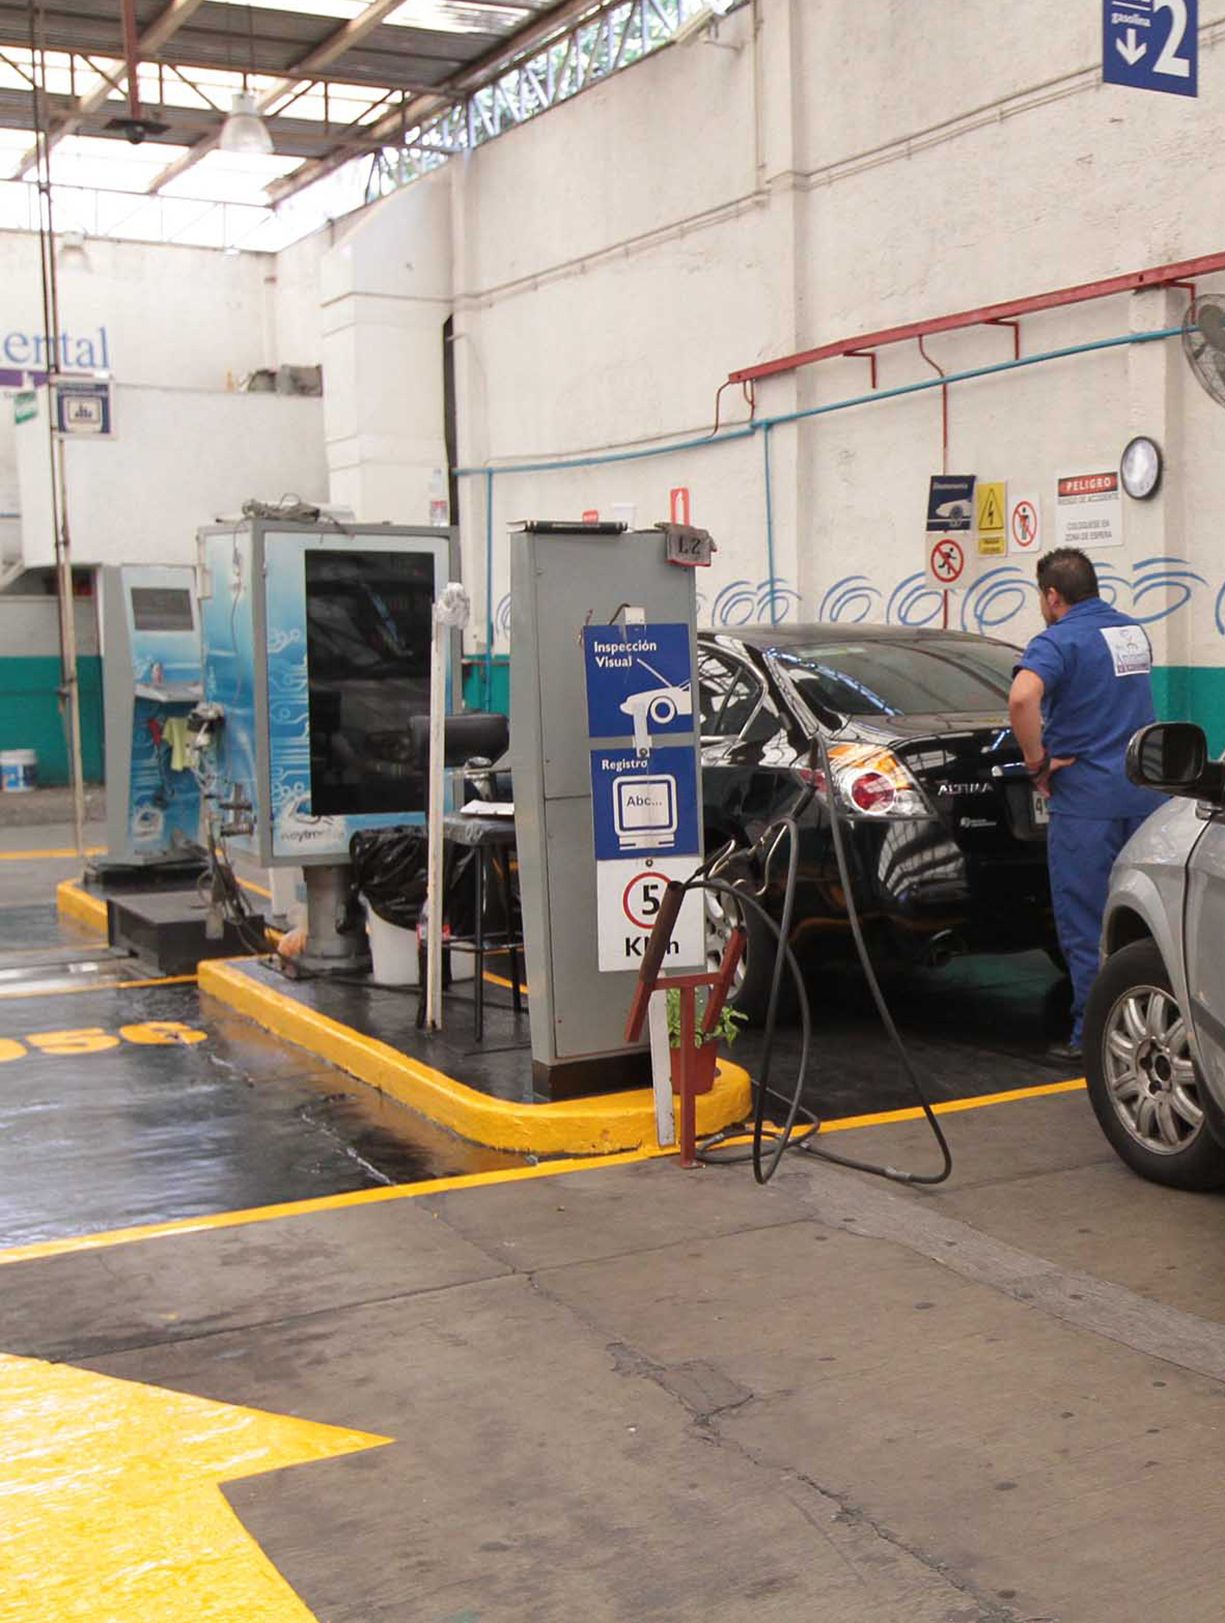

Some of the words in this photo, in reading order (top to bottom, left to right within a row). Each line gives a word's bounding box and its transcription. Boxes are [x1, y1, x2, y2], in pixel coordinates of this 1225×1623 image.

[1152, 0, 1190, 78] 2
[1066, 477, 1112, 491] PELIGRO
[593, 640, 657, 655] Inspección
[595, 655, 632, 668] Visual
[601, 758, 648, 772] Registro
[642, 884, 661, 915] 5
